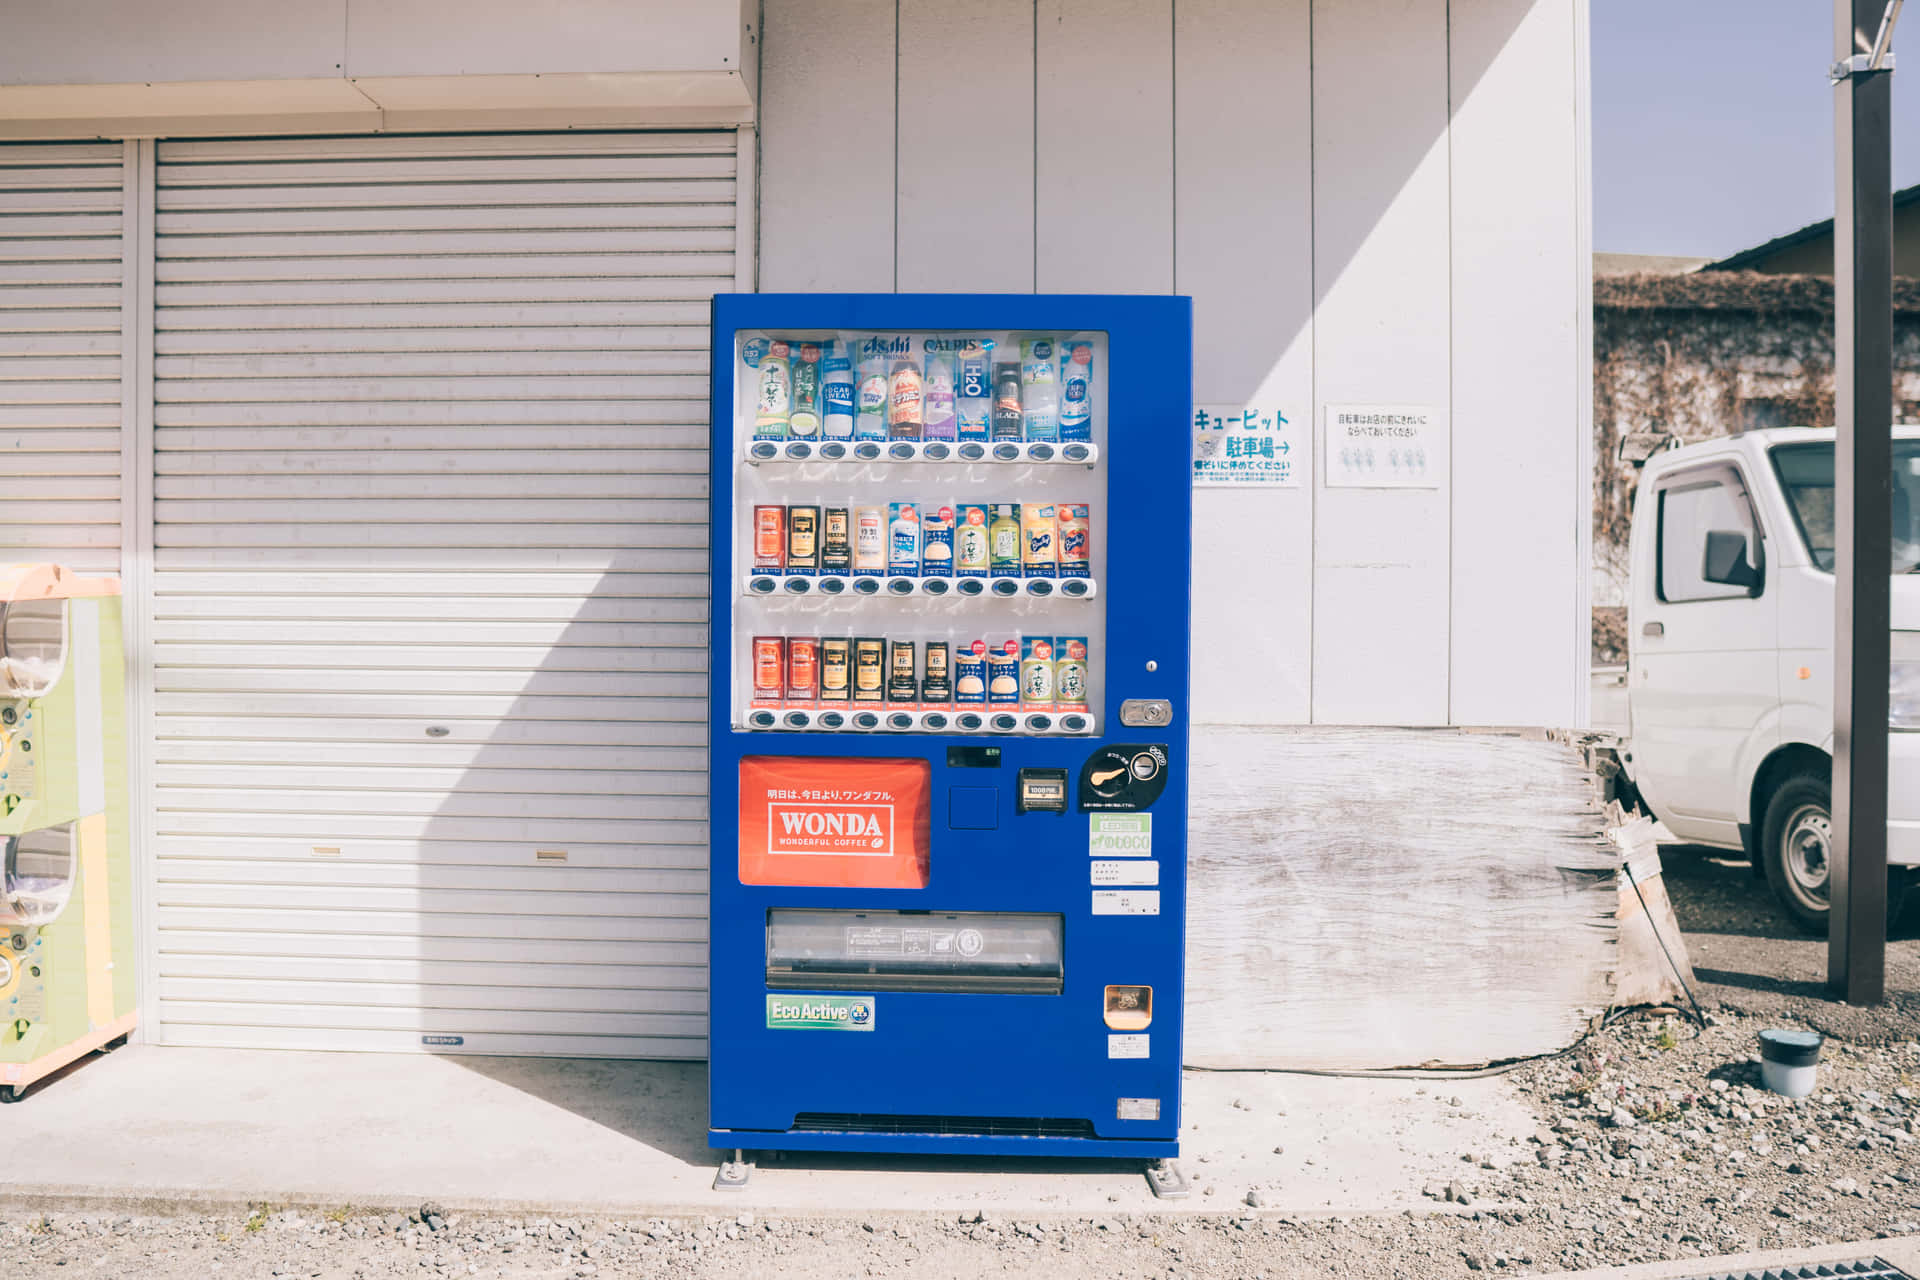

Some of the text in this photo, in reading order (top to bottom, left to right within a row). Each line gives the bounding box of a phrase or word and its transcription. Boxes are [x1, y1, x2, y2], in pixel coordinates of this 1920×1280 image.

[864, 336, 910, 353] Asahi
[923, 337, 977, 353] CALPIS
[1194, 409, 1289, 431] キューピット
[1226, 436, 1274, 459] 駐車場
[768, 789, 895, 802] 明日は、今日より、ワンダフル。
[779, 812, 883, 836] WONDA
[779, 838, 830, 846] WONDERFUL
